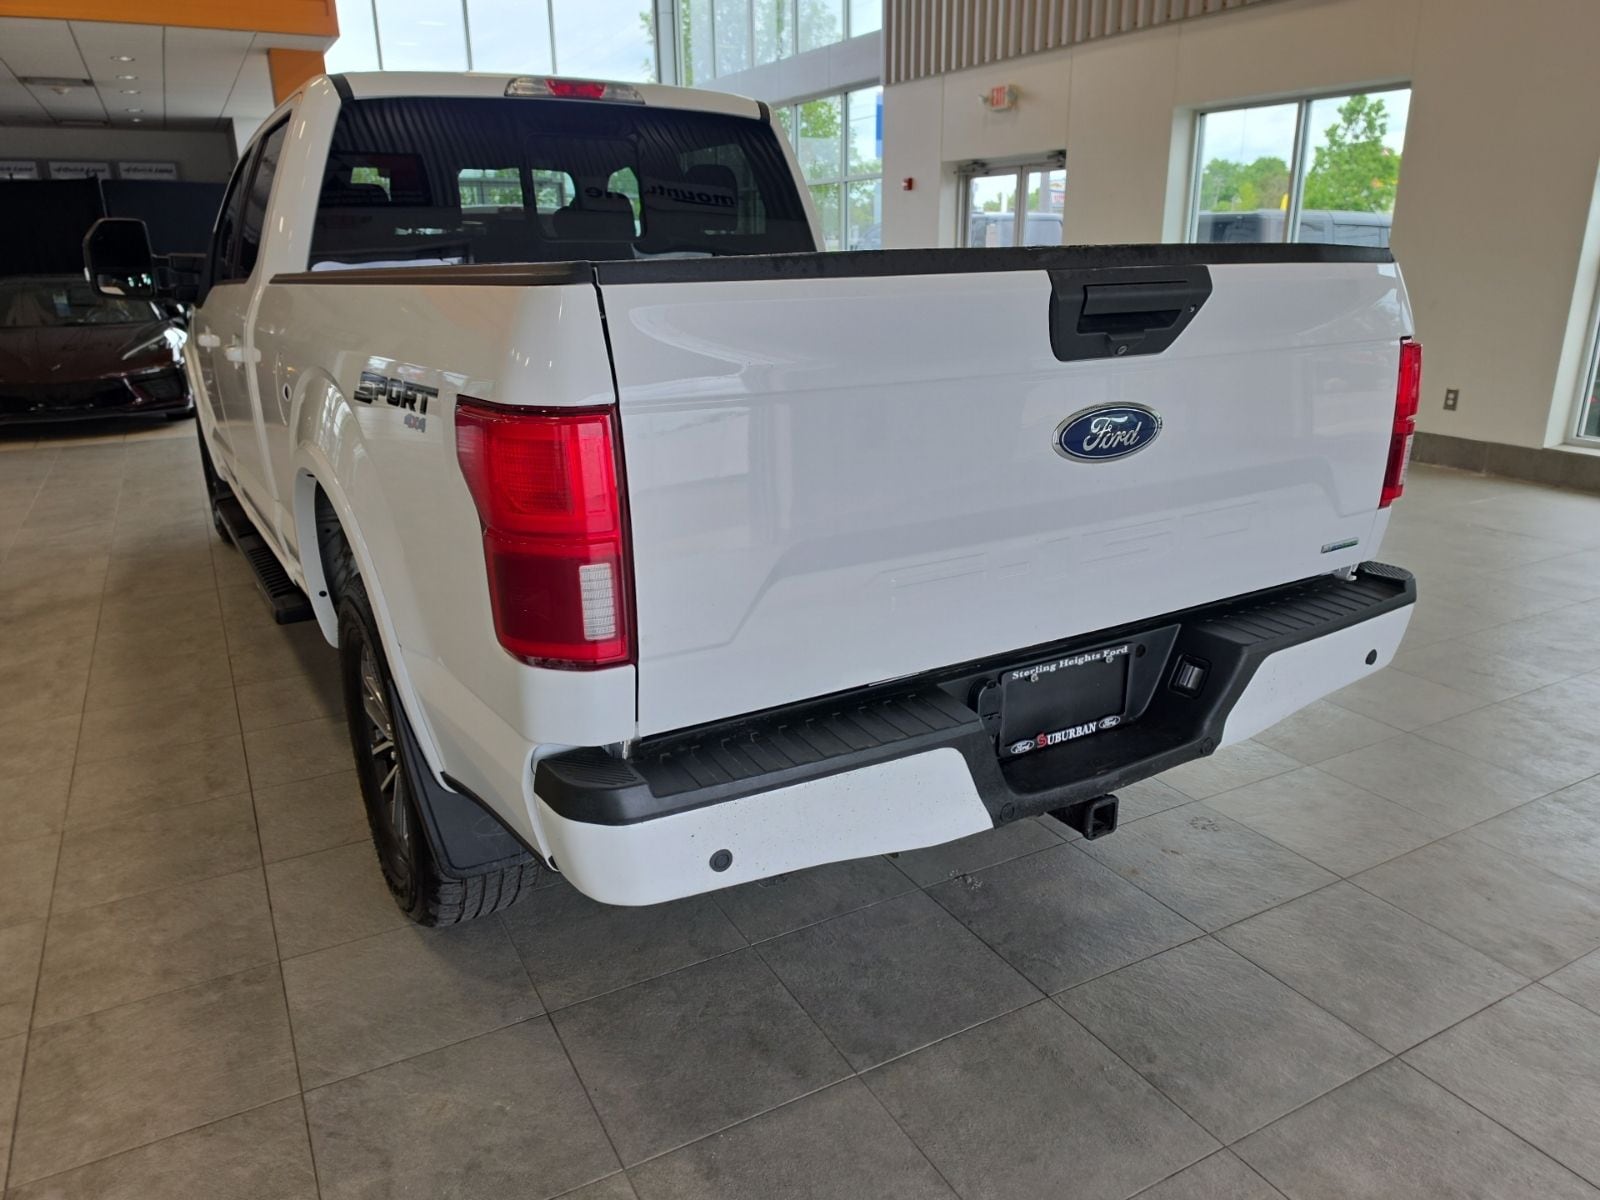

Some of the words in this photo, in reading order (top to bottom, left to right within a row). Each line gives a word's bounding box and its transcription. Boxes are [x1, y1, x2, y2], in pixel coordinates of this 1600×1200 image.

[353, 371, 440, 415] SPORT
[1082, 415, 1142, 452] Ford
[1011, 662, 1057, 680] Sterling
[1059, 652, 1101, 668] Heights
[1103, 645, 1128, 659] Ford
[1036, 722, 1097, 749] SUBURBAN
